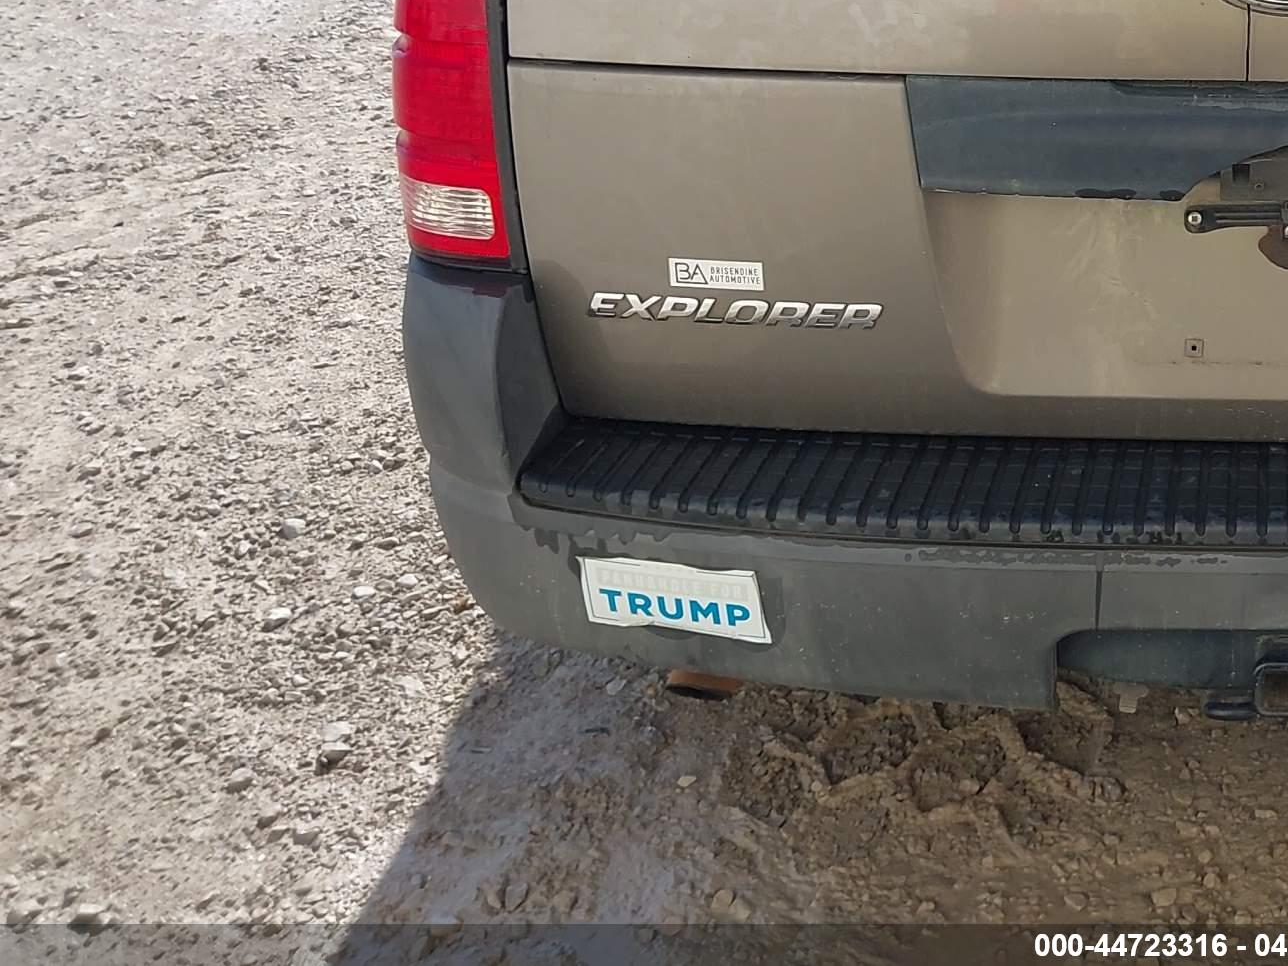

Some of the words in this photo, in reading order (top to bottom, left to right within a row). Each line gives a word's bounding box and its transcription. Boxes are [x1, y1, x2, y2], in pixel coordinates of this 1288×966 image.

[674, 262, 709, 285] BA
[709, 275, 761, 285] AUTOMOTIVE
[710, 266, 759, 277] BRISENDINE
[587, 291, 884, 330] EXPLORER
[599, 588, 750, 626] TRUMP
